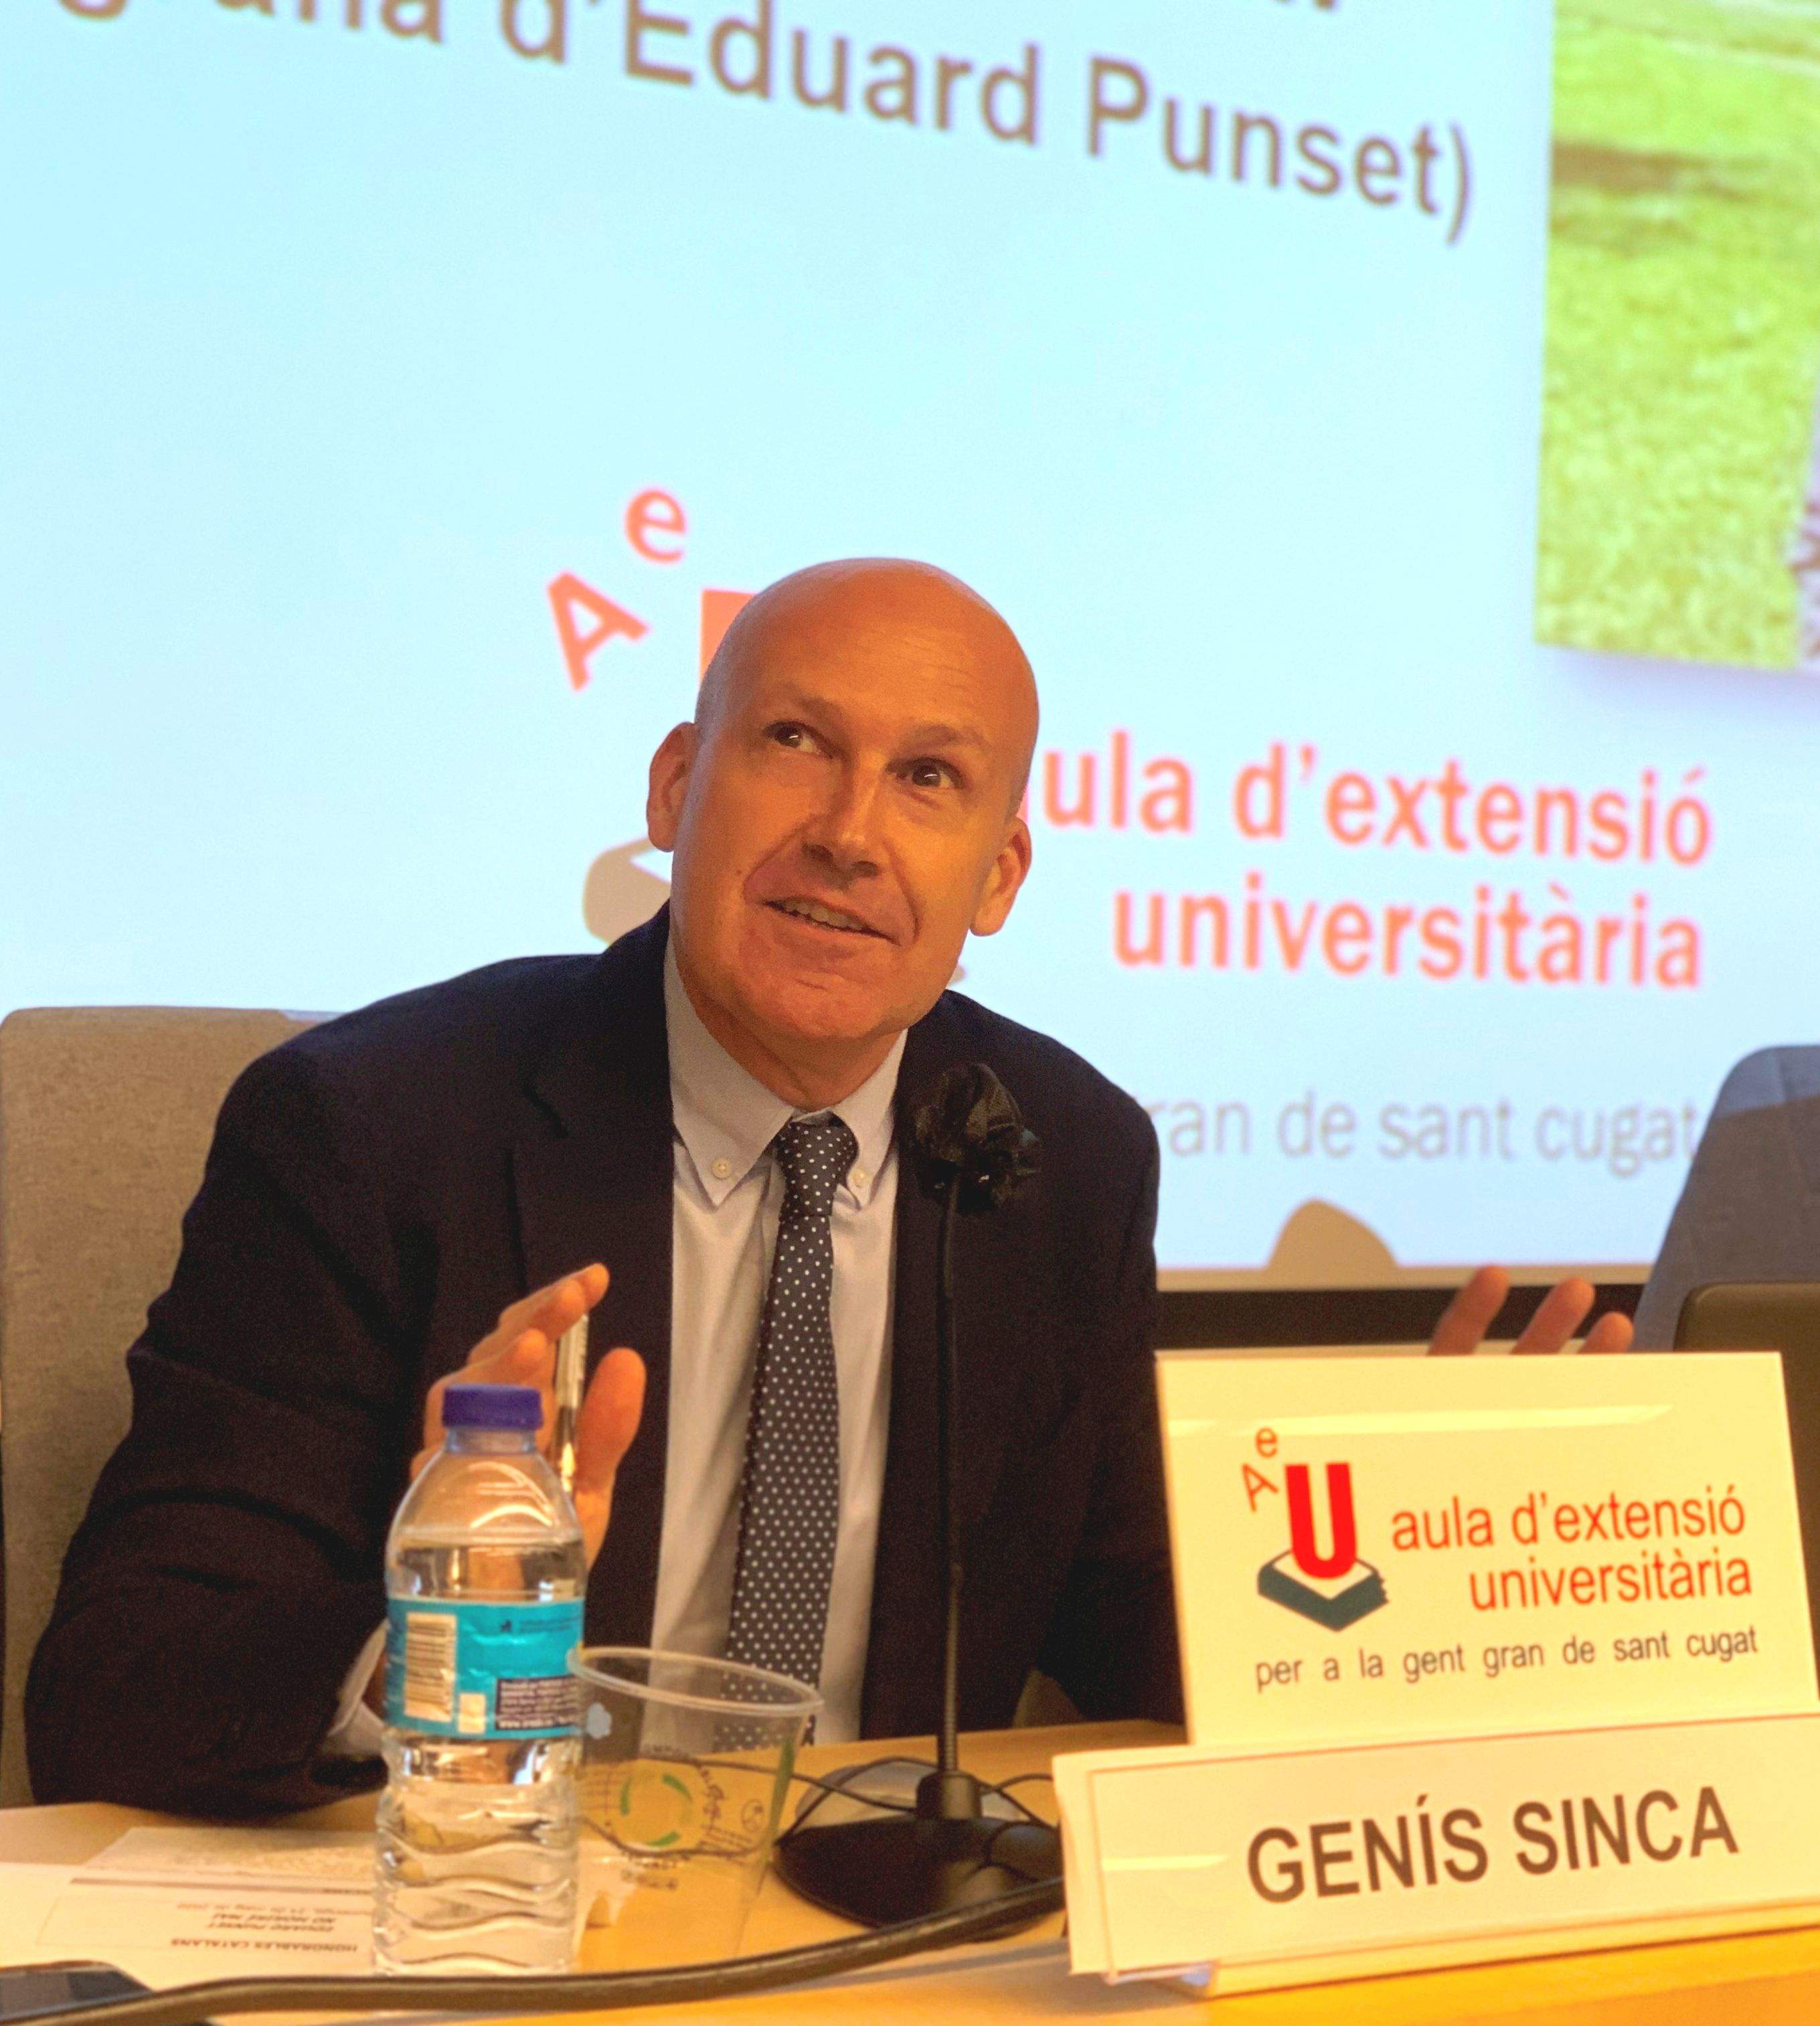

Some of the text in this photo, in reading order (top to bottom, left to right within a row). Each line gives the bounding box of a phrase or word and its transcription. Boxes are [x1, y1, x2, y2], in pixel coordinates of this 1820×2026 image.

[497, 0, 1473, 246] dEduard Punset)
[547, 572, 648, 690] A
[1024, 729, 1193, 833] ula
[1115, 871, 1701, 988] universitària
[1277, 1089, 1355, 1158] de
[1378, 1096, 1515, 1160] sant
[1284, 1462, 1358, 1580] U
[1391, 1494, 1495, 1552] aula
[1468, 1547, 1753, 1612] universitària
[1255, 1624, 1759, 1693] per a la gent gran de sant cugat
[1246, 1786, 1740, 1903] GENÍS SINCA
[170, 1938, 357, 1952] HONORABLES CATALANS
